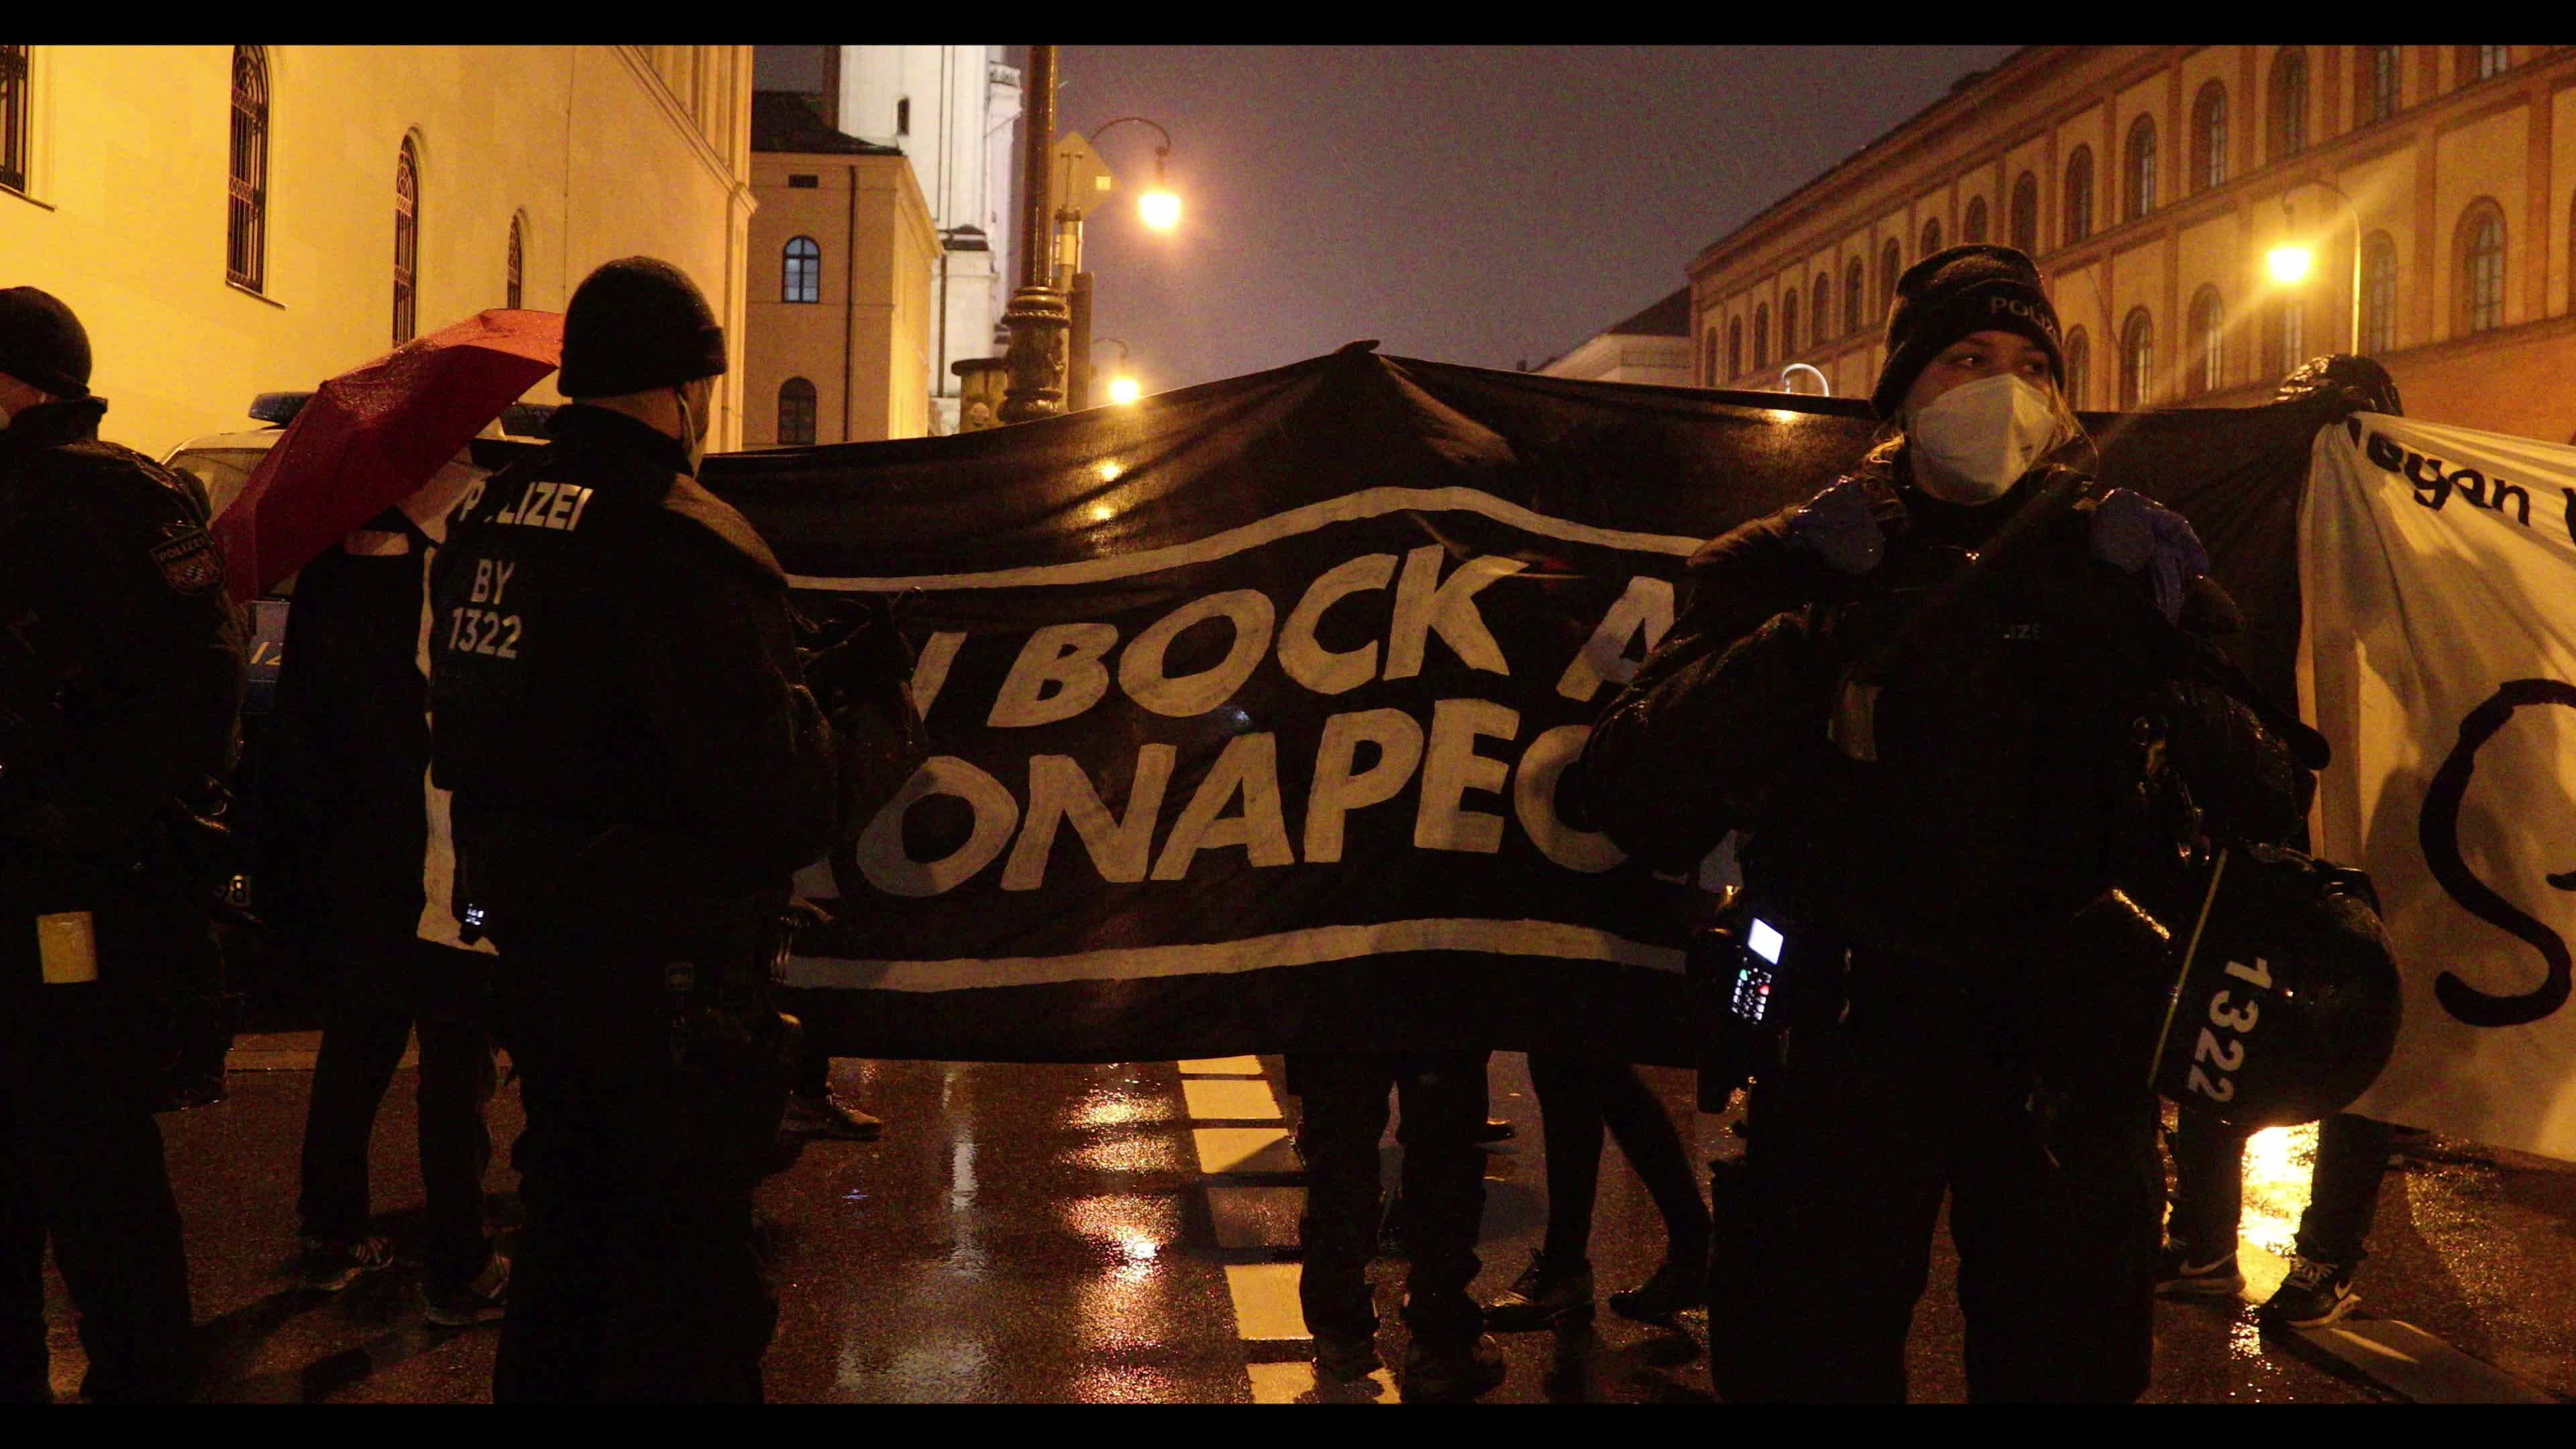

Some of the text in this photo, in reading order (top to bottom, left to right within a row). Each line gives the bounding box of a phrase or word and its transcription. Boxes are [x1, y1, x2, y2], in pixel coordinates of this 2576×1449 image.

[458, 480, 594, 531] PLIZEI
[448, 606, 524, 659] 1322
[472, 558, 516, 604] BY
[987, 543, 1529, 728] BOCK
[790, 698, 1744, 899] ONAPEC
[2420, 679, 2576, 1027] S
[2188, 955, 2273, 1103] 1322
